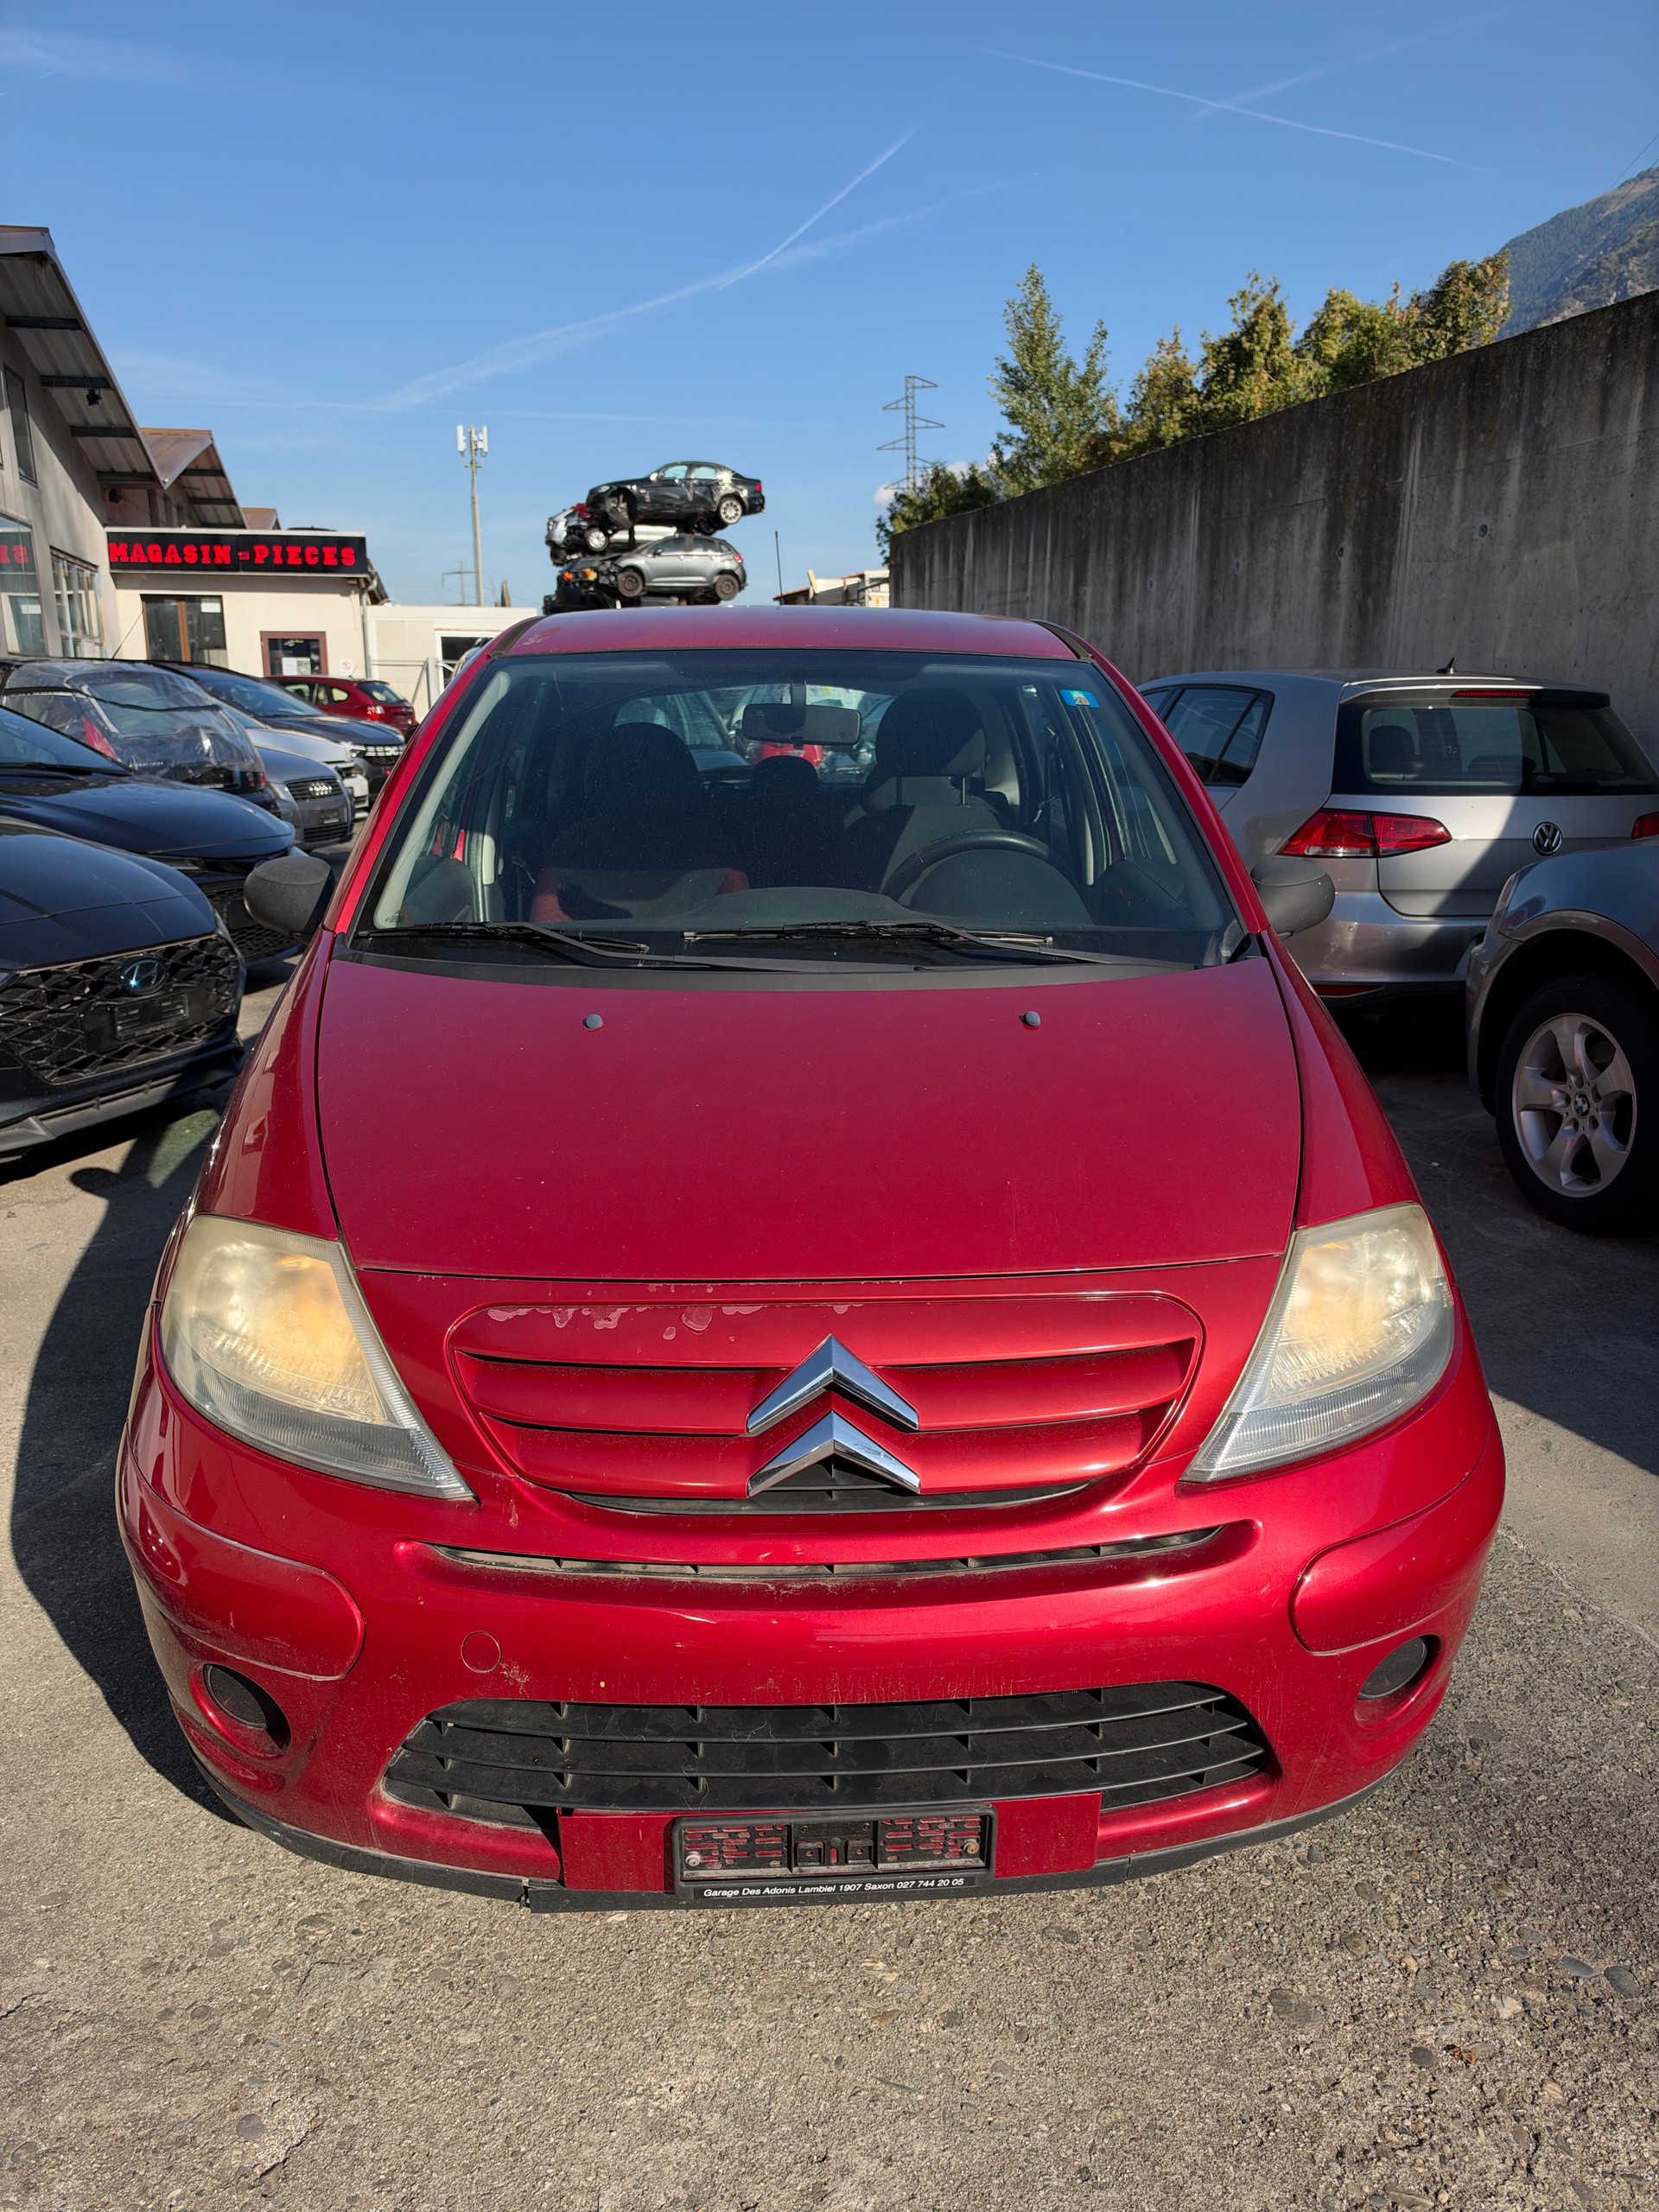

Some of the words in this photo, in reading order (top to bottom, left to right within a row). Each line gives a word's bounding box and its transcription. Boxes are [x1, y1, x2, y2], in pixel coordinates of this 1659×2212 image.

[108, 543, 232, 565] MAGASIN
[703, 1889, 740, 1897] Garage
[741, 1887, 761, 1896] Des
[762, 1886, 796, 1895] Adonis
[798, 1885, 836, 1893] Lambiel
[863, 1882, 894, 1891] Saxon
[896, 1881, 916, 1890] 027
[917, 1879, 935, 1888] 744
[937, 1878, 950, 1887] 20
[951, 1878, 964, 1886] 05
